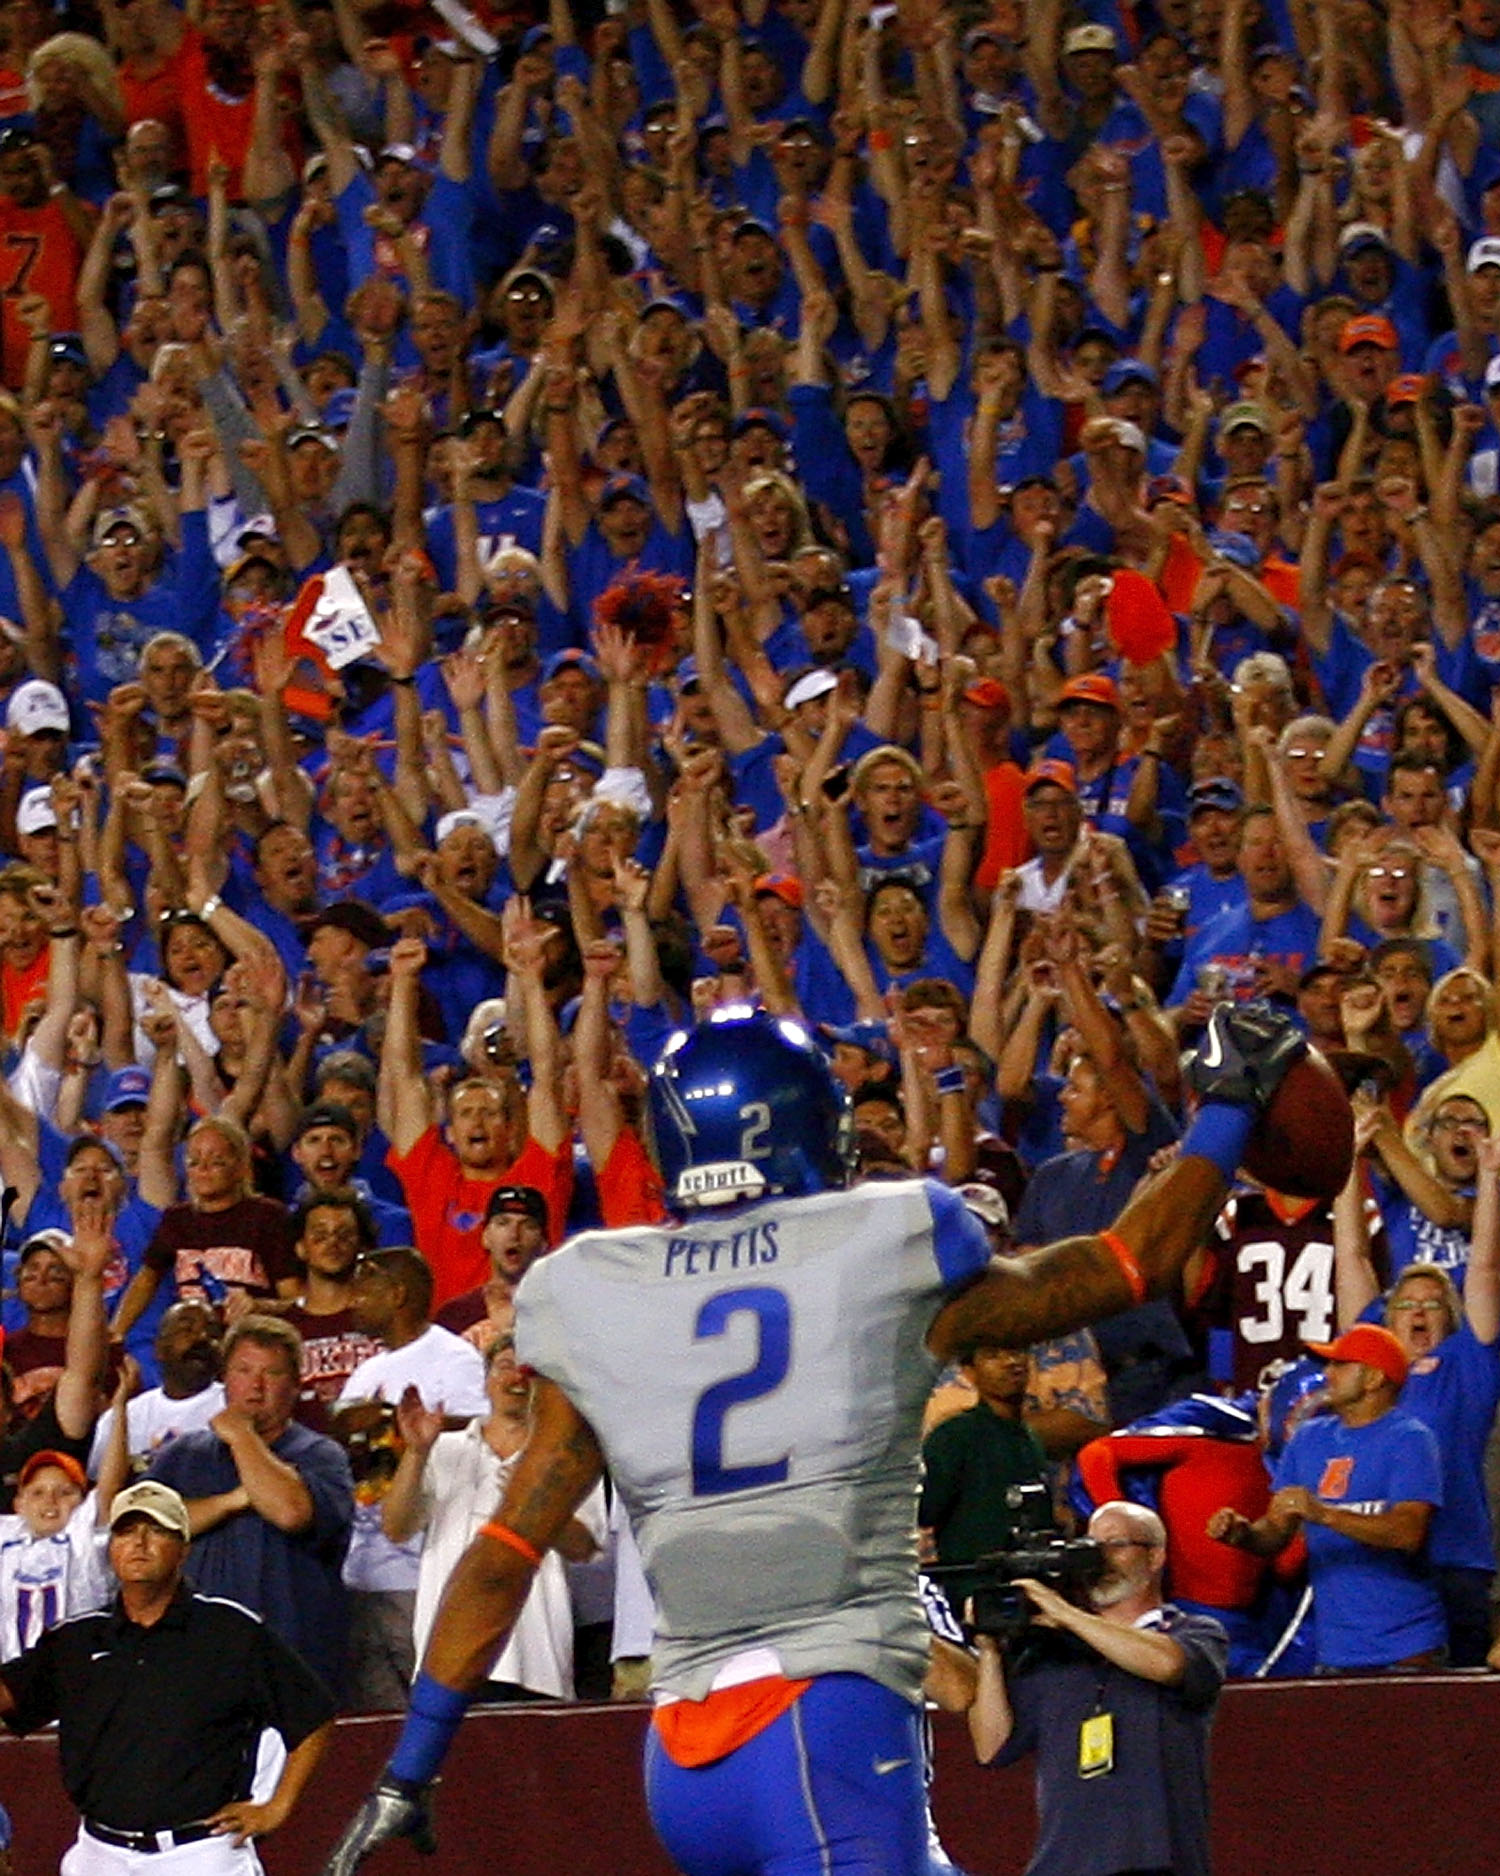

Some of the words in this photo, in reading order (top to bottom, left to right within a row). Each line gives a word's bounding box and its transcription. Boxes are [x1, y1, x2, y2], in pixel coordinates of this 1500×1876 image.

[5, 234, 41, 296] 7
[739, 1102, 772, 1160] 2
[664, 1221, 779, 1277] PETTIS
[1237, 1242, 1334, 1343] 34
[692, 1286, 792, 1496] 2
